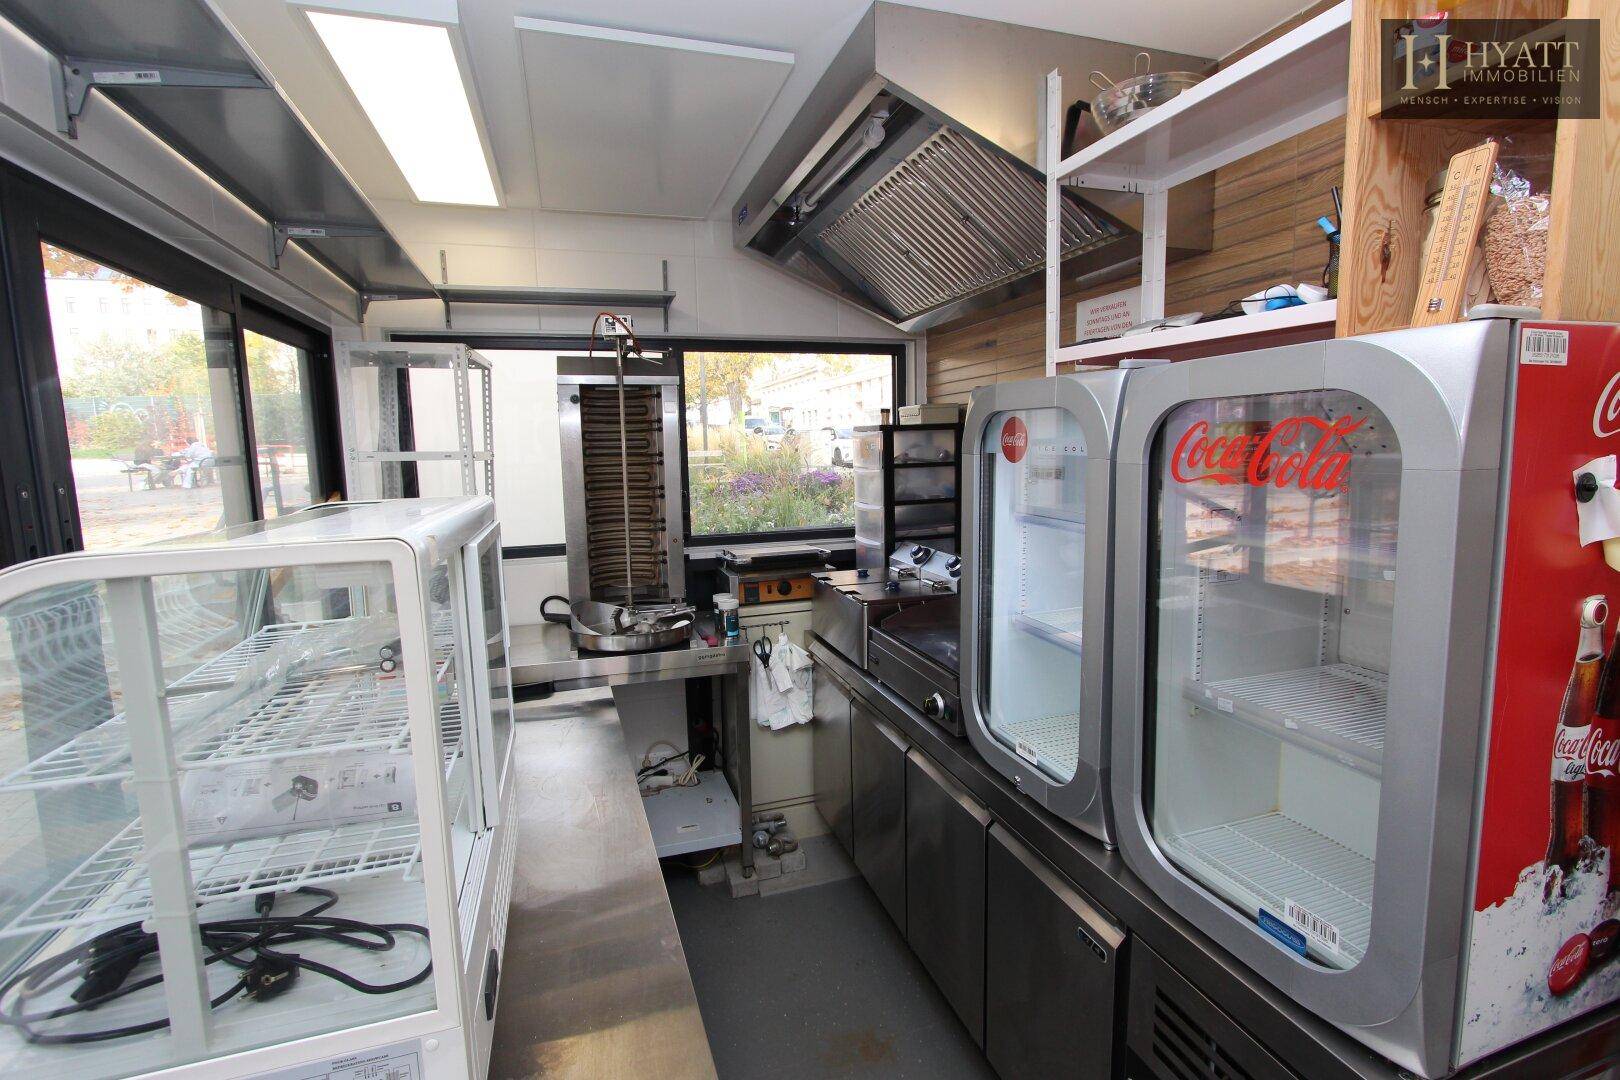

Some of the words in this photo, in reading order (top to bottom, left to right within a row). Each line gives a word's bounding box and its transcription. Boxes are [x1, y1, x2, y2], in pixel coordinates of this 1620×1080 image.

[1089, 307, 1100, 315] WIR
[1100, 300, 1127, 312] VERKAUFEN
[1086, 315, 1111, 326] SONNTAGS
[1110, 312, 1121, 321] UND
[1110, 323, 1121, 331] VON
[1121, 320, 1133, 329] DEN
[1064, 445, 1085, 453] COL
[1170, 415, 1368, 490] Coca-Cola
[1554, 728, 1588, 761] Coca-C
[1564, 761, 1586, 780] lig
